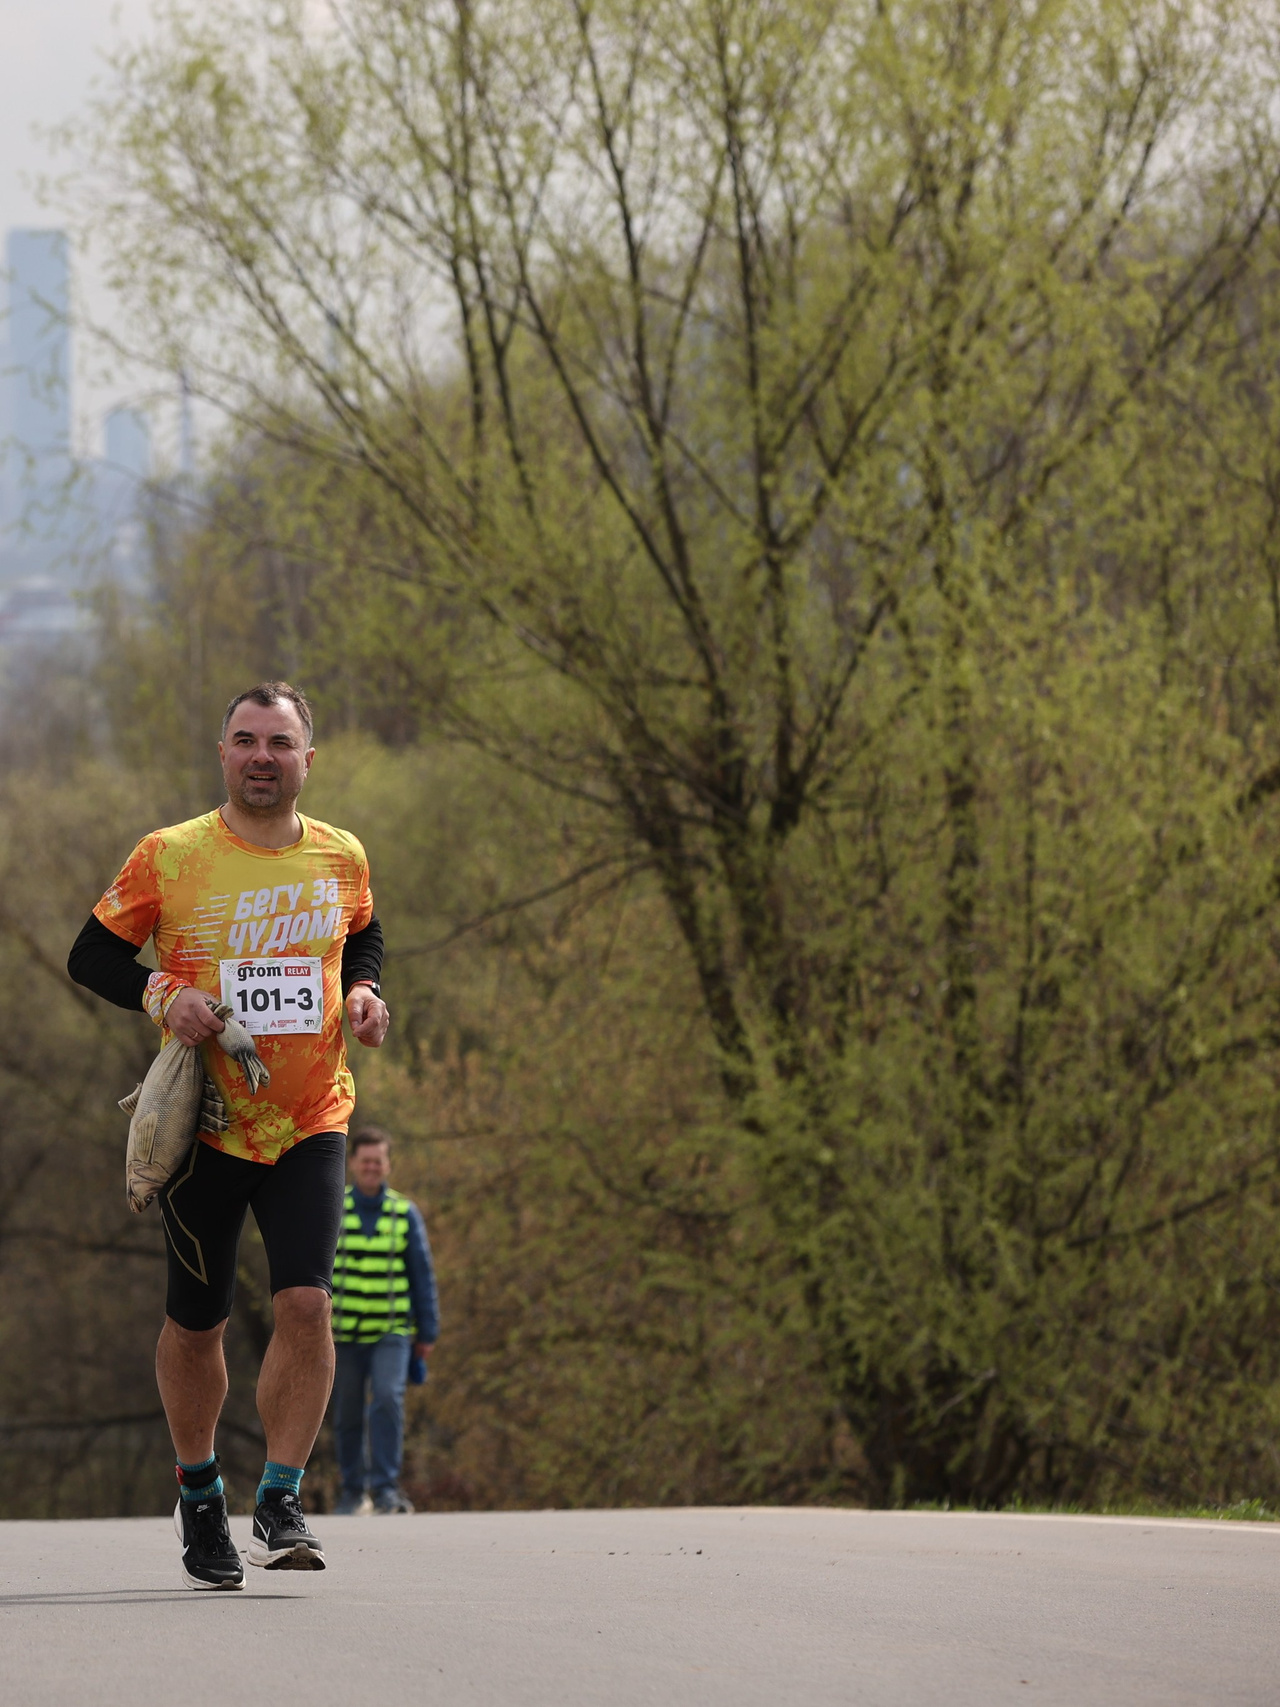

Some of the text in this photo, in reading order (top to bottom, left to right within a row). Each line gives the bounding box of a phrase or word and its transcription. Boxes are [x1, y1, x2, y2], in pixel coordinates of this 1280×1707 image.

[228, 906, 342, 955] ЧУДОМ!
[237, 965, 309, 981] grom RELAY
[237, 987, 314, 1012] 101-3
